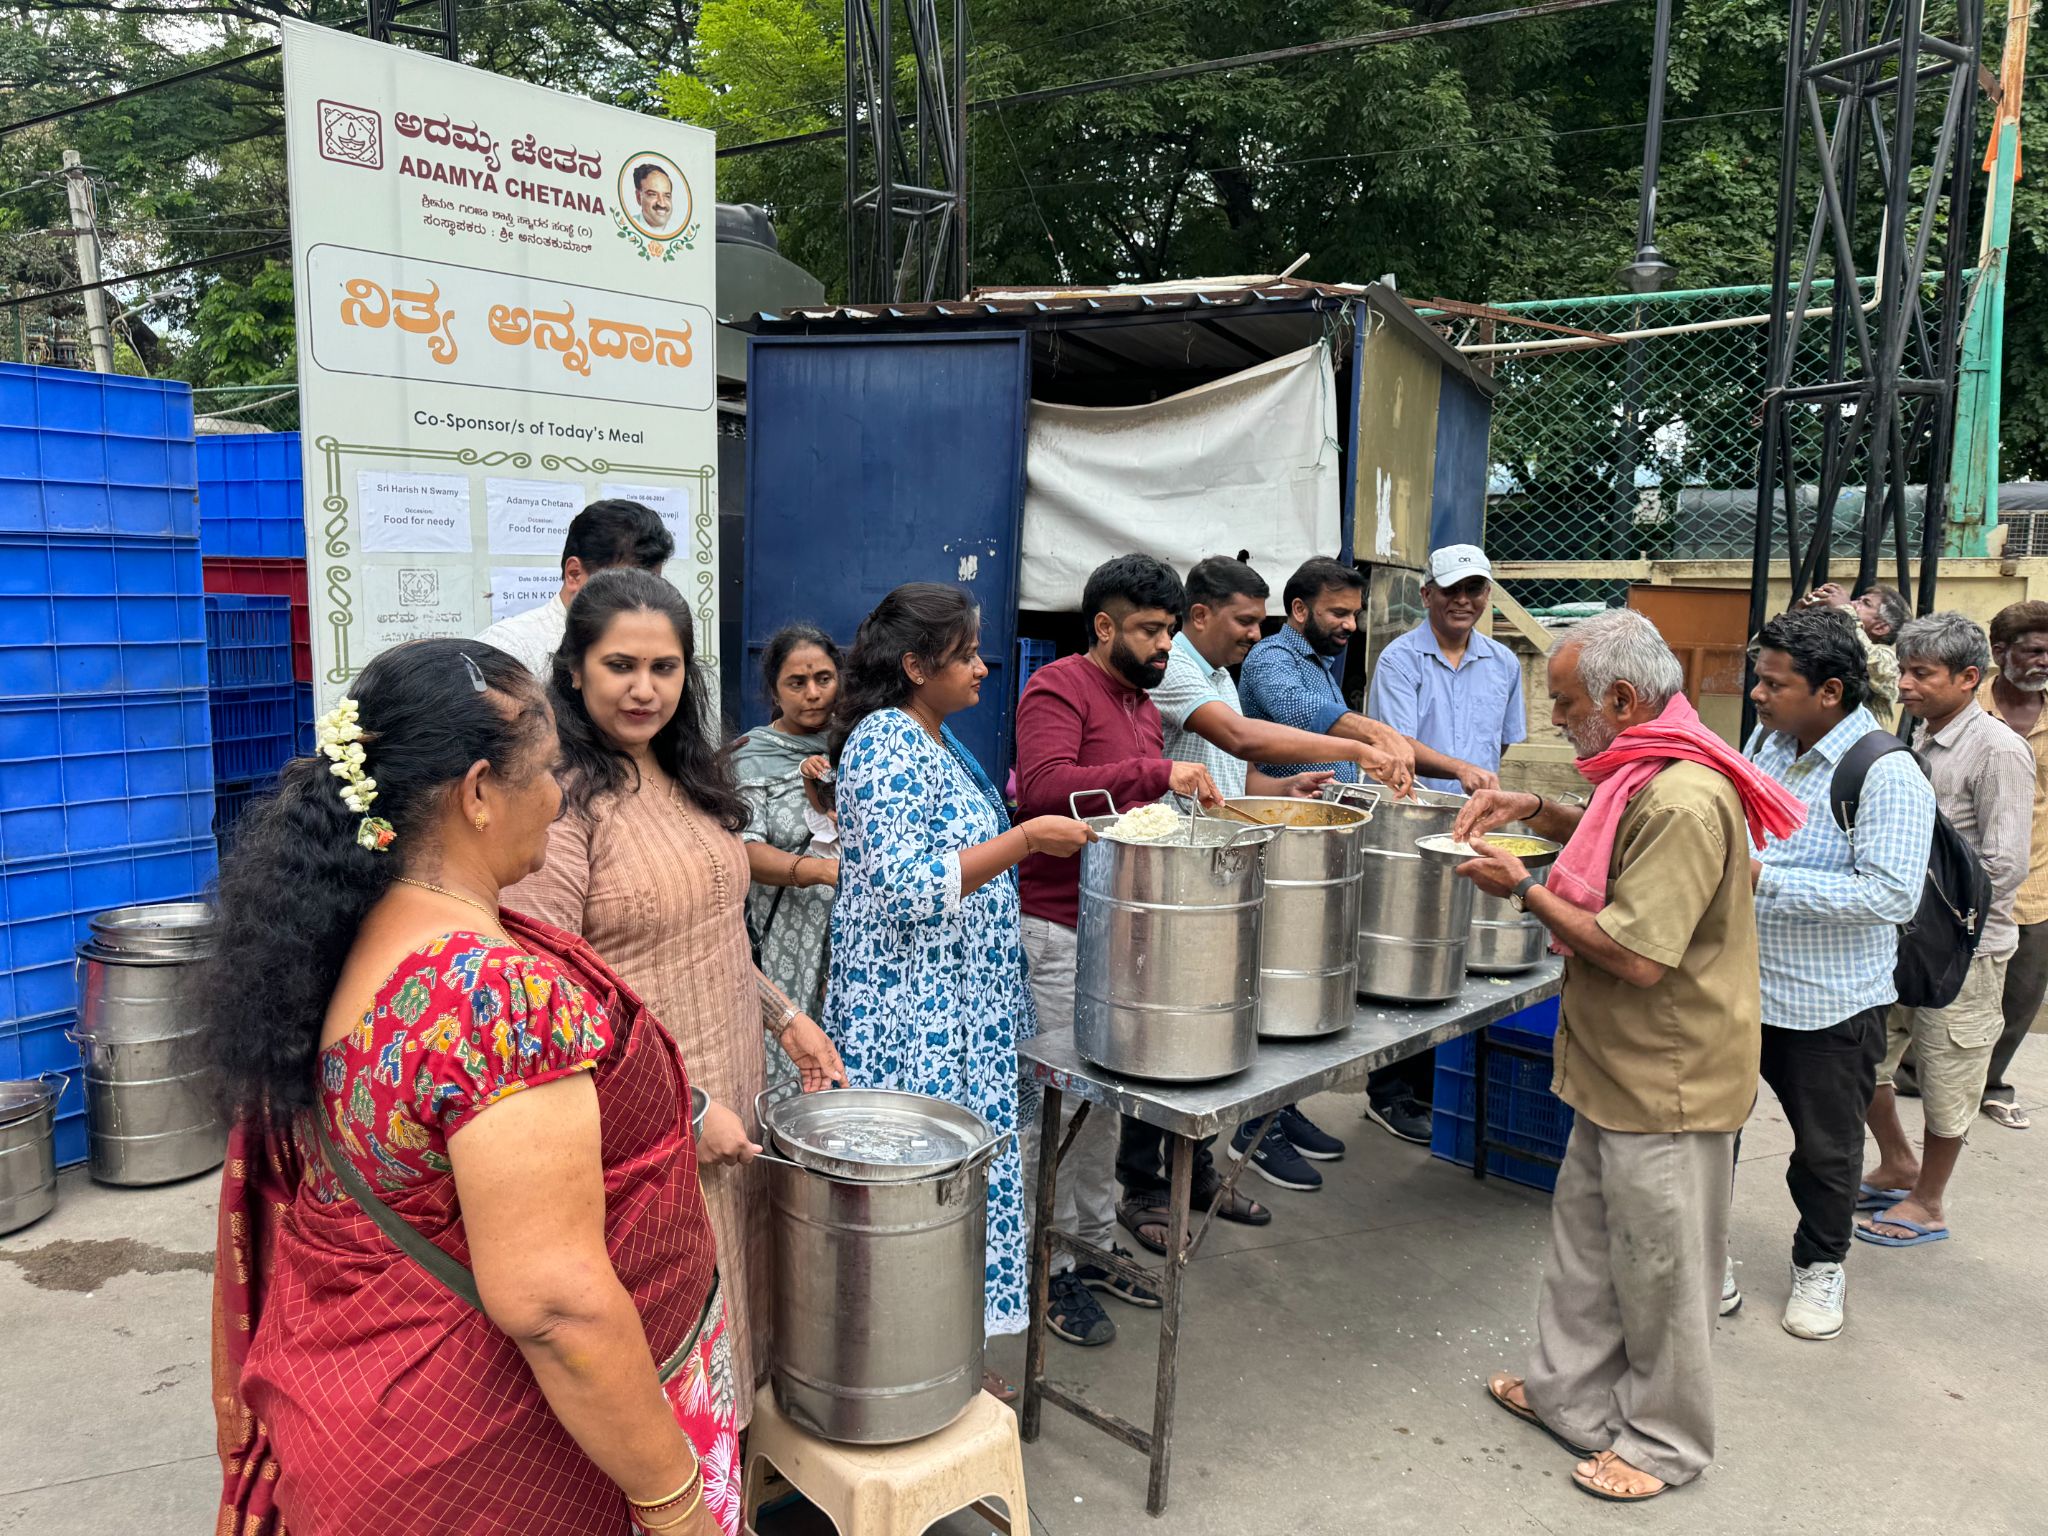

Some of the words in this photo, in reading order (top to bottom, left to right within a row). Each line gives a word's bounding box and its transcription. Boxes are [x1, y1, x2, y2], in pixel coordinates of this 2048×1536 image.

[394, 111, 502, 173] ಅದಮ್ಯ
[511, 133, 602, 180] ಚೇತನ
[399, 155, 499, 194] ADAMYA
[505, 177, 606, 216] CHETANA
[423, 214, 487, 237] ಸಂಸ್ಥಾಪಕರು
[499, 227, 514, 242] ಶ್ರೀ
[518, 233, 592, 254] ಅನಂತಕುಮಾರ್
[340, 278, 458, 365] ನಿತ್ಯ
[488, 299, 693, 378] ಅನ್ನದಾನ
[414, 410, 525, 435] Co-Sponsor/s
[530, 421, 545, 435] of
[548, 422, 604, 442] Today's
[608, 428, 644, 444] Meal
[377, 484, 389, 492] Sri
[391, 485, 419, 494] Harish
[421, 486, 428, 494] N
[430, 487, 459, 498] Swamy
[506, 496, 540, 508] Adamya
[541, 498, 574, 508] Chetana
[383, 515, 409, 524] Food
[411, 516, 425, 525] for
[427, 517, 455, 528] needy
[508, 523, 531, 533] Food
[533, 525, 545, 534] for
[547, 527, 569, 535] need
[503, 592, 515, 600] Sri
[517, 592, 530, 600] CH
[532, 592, 538, 600] N
[540, 592, 546, 600] K
